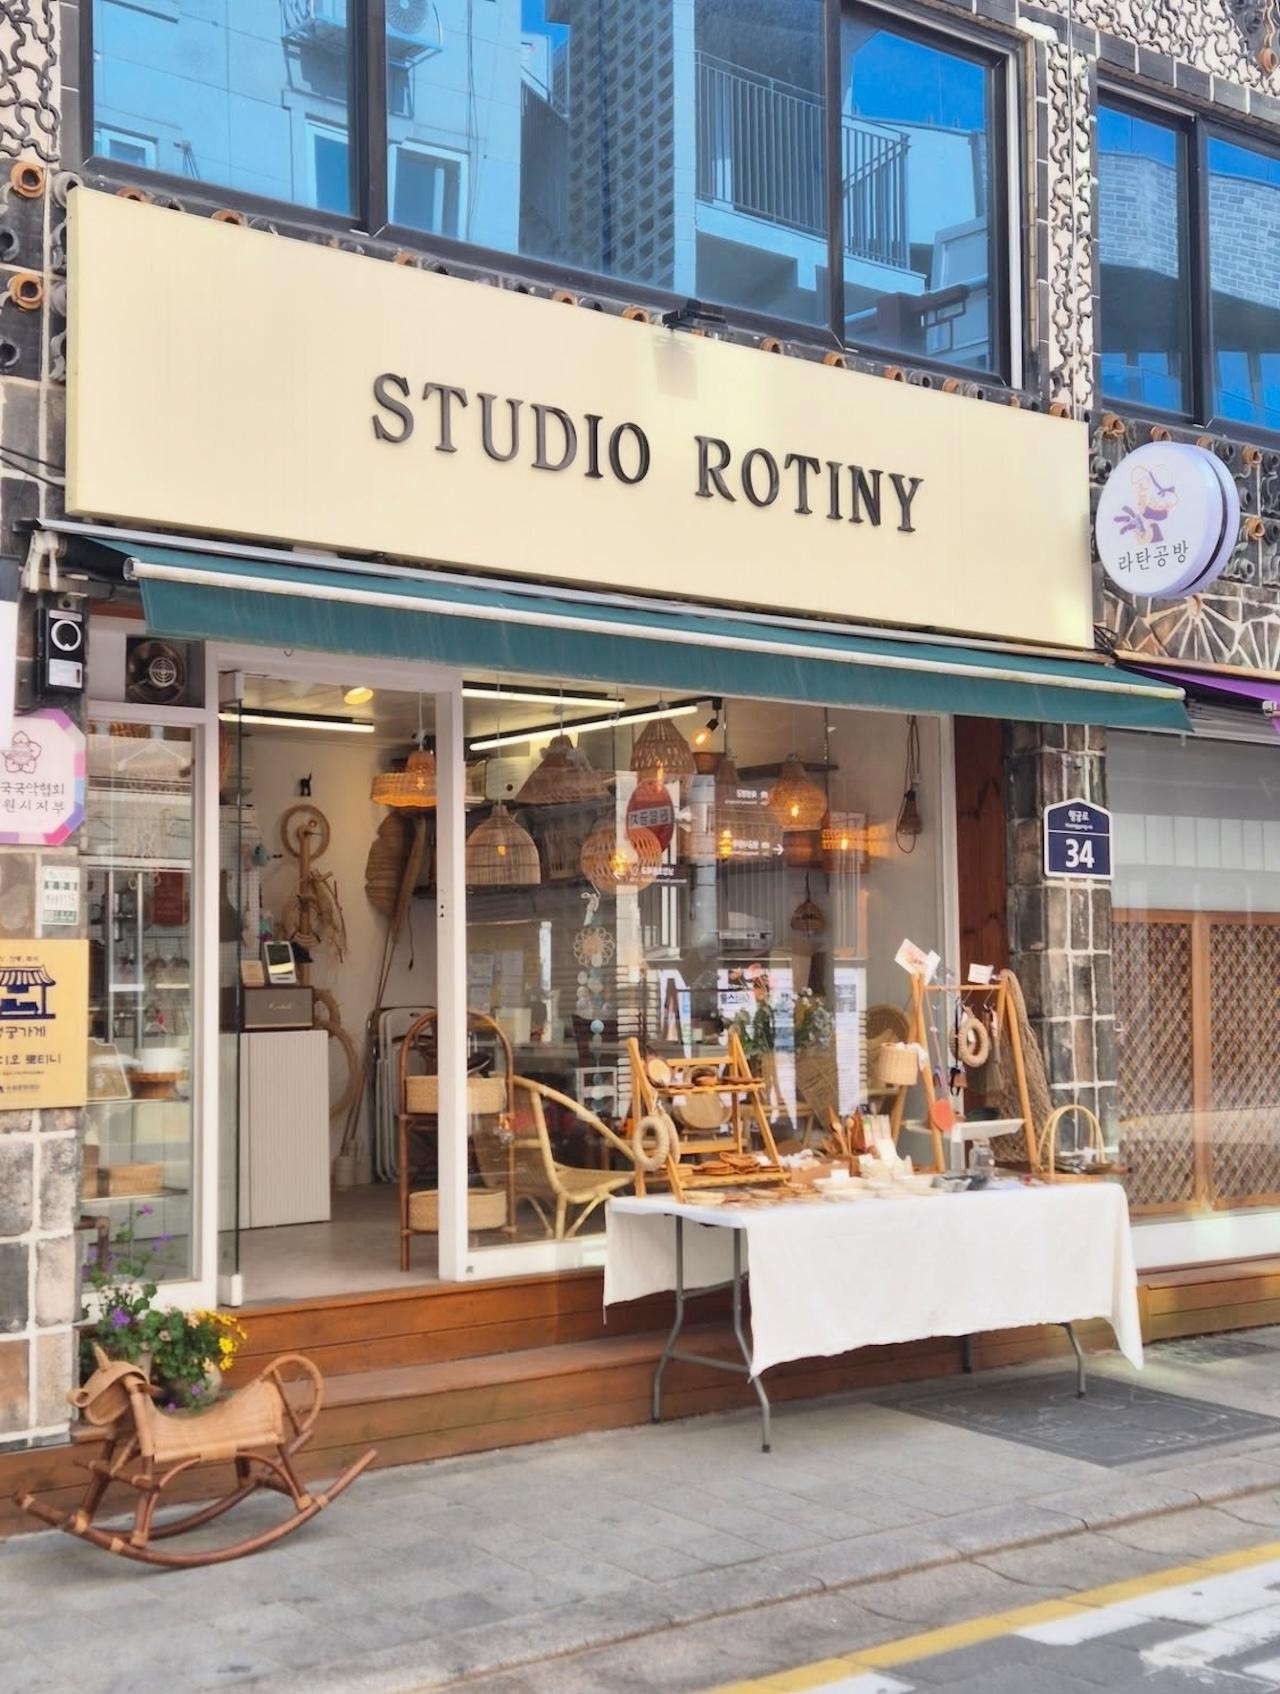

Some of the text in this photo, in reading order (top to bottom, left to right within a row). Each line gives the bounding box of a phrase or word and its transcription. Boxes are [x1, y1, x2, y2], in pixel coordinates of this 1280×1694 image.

[372, 373, 924, 533] STUDIO ROTINY
[1118, 539, 1189, 573] 라탄공방
[1065, 838, 1095, 869] 34
[0, 1025, 46, 1040] 궁가게
